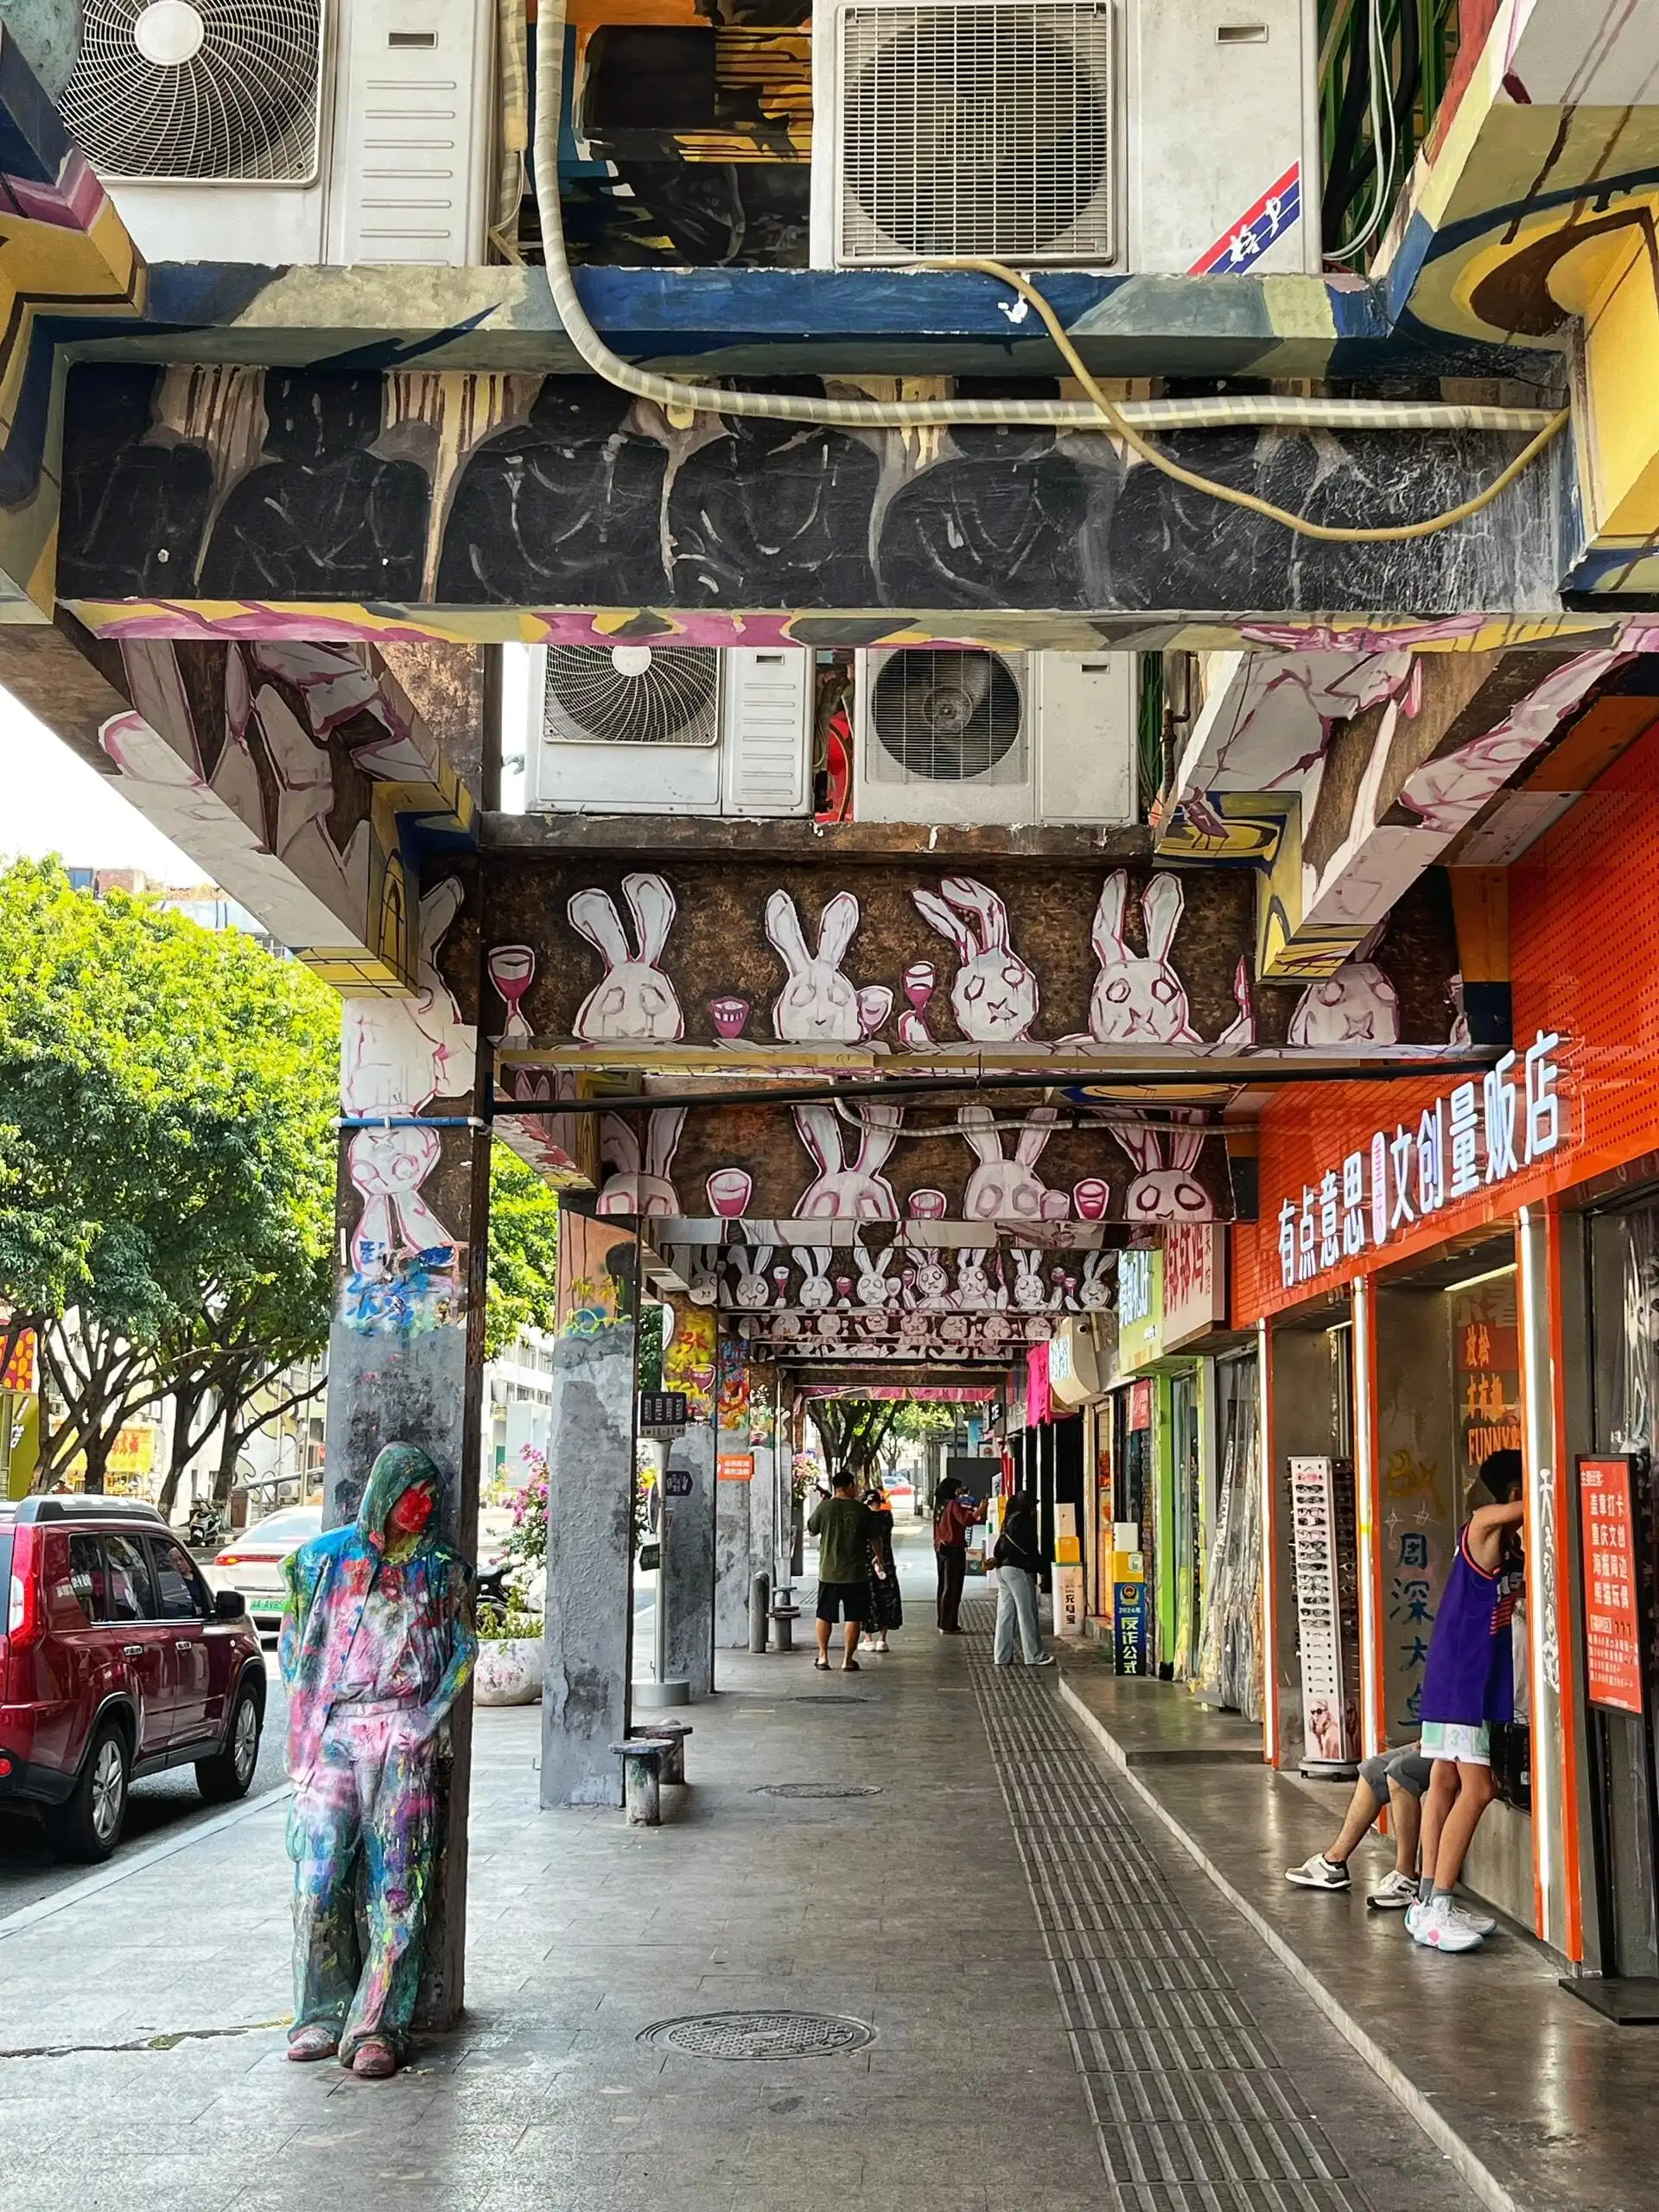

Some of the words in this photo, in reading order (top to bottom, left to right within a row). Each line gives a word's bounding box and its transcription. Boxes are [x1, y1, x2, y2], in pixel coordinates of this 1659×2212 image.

[1389, 1029, 1559, 1230] 文创量贩店
[1278, 1151, 1364, 1288] 有点意思
